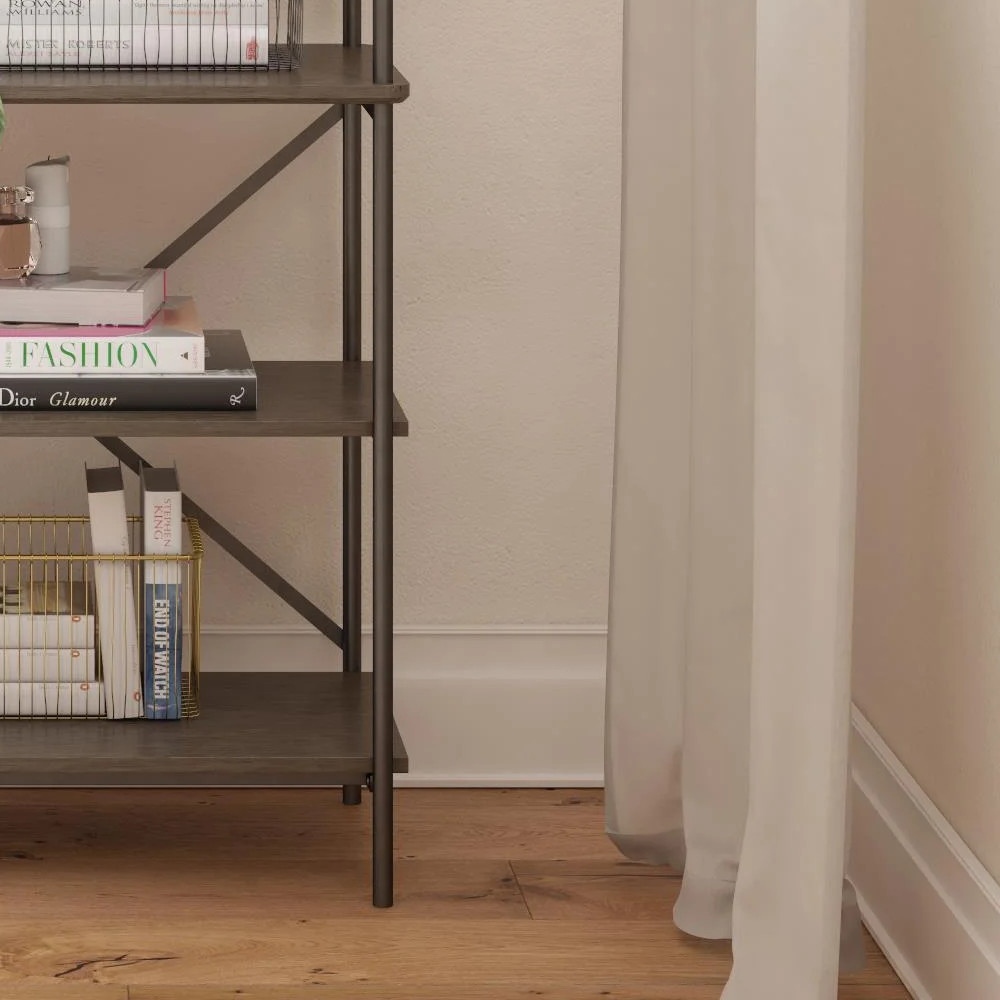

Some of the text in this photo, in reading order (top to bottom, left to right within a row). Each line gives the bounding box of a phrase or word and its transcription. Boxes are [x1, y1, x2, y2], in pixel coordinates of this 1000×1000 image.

[21, 341, 159, 368] FASHION
[49, 391, 117, 407] Glamour
[153, 504, 163, 540] KING
[163, 498, 172, 547] STEPHEN
[153, 599, 169, 699] END OF WATCH
